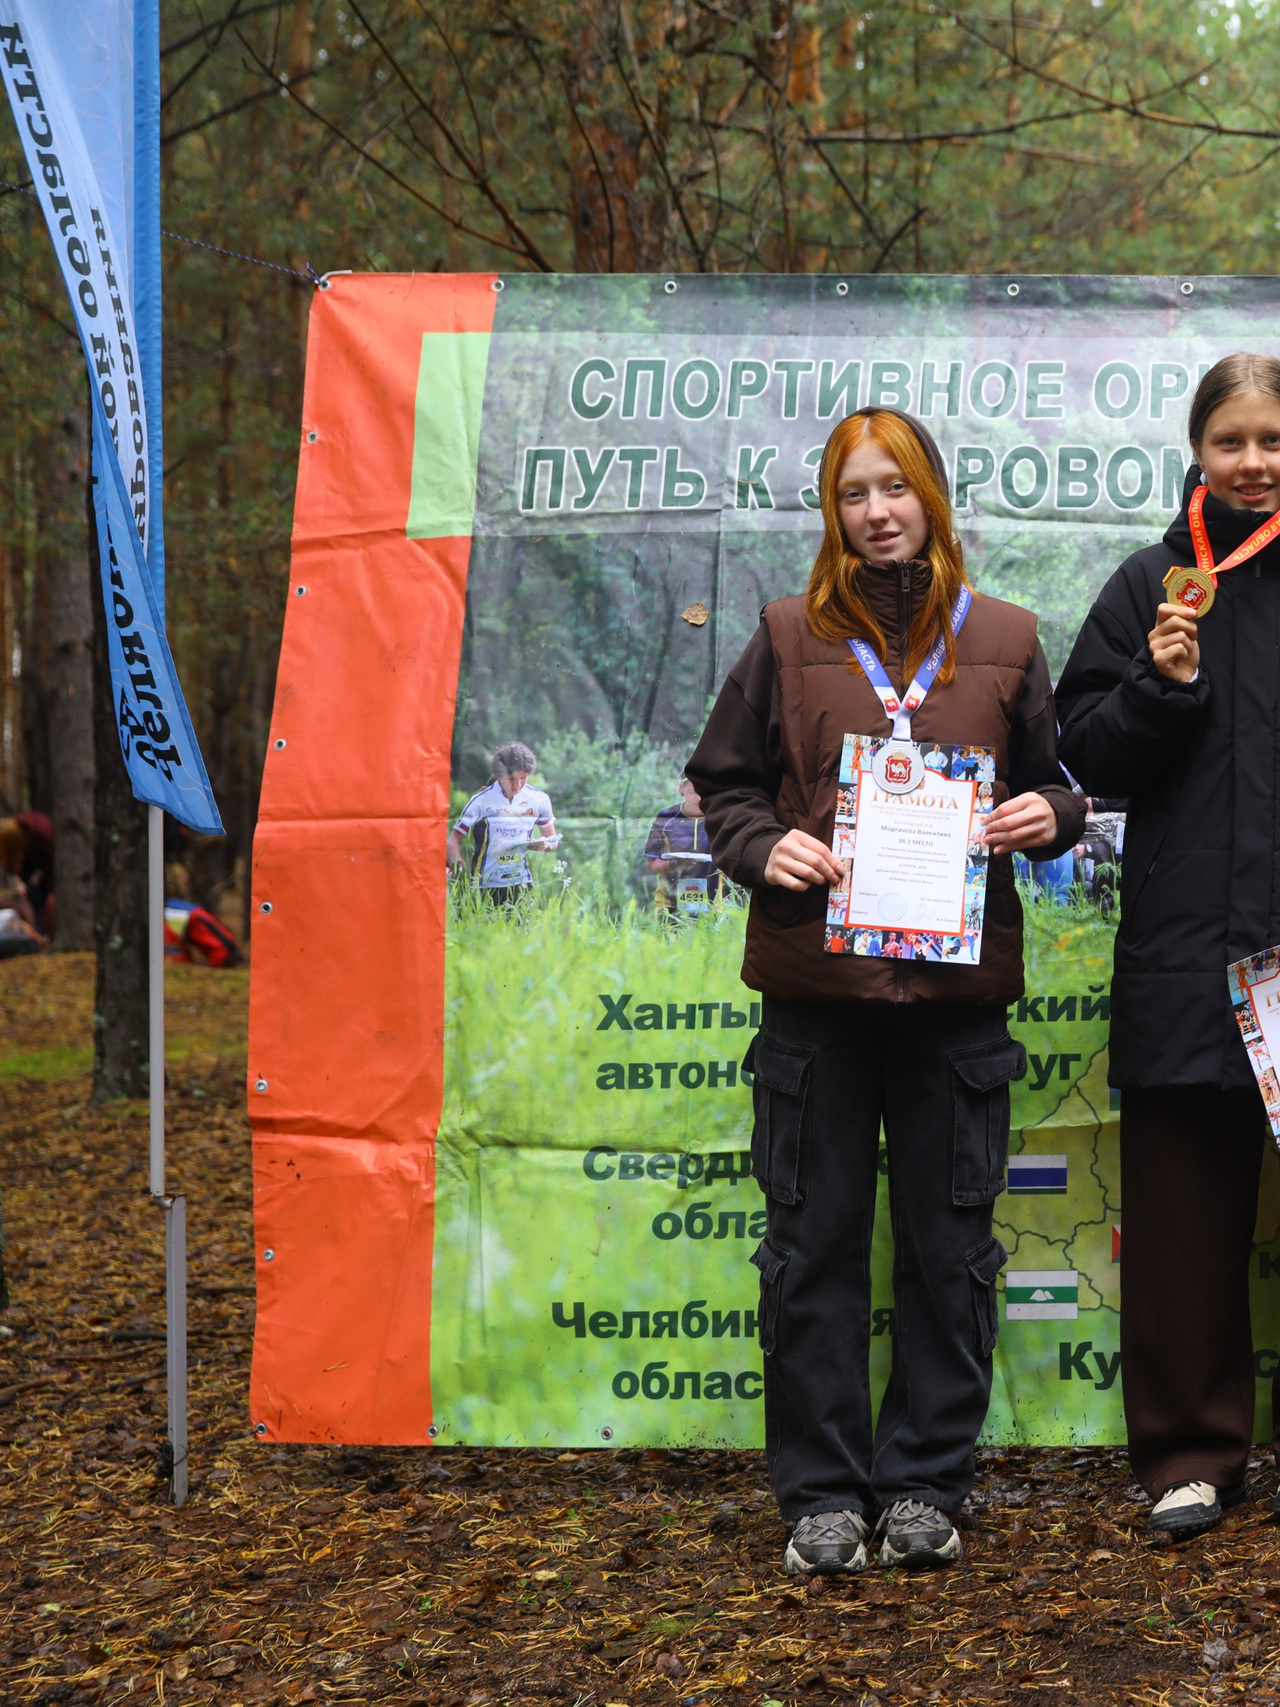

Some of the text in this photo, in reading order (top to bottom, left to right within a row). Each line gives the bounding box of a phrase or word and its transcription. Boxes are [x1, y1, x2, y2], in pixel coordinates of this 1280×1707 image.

[569, 357, 1065, 421] СПОРТИВНОЕ
[520, 446, 708, 511] ПУТЬ
[733, 445, 778, 511] К
[1232, 529, 1271, 561] ОБЛАСТЬ
[852, 638, 877, 671] БЛАСТЬ
[596, 1061, 754, 1089] автон
[652, 1202, 768, 1240] обла
[612, 1361, 764, 1399] облас
